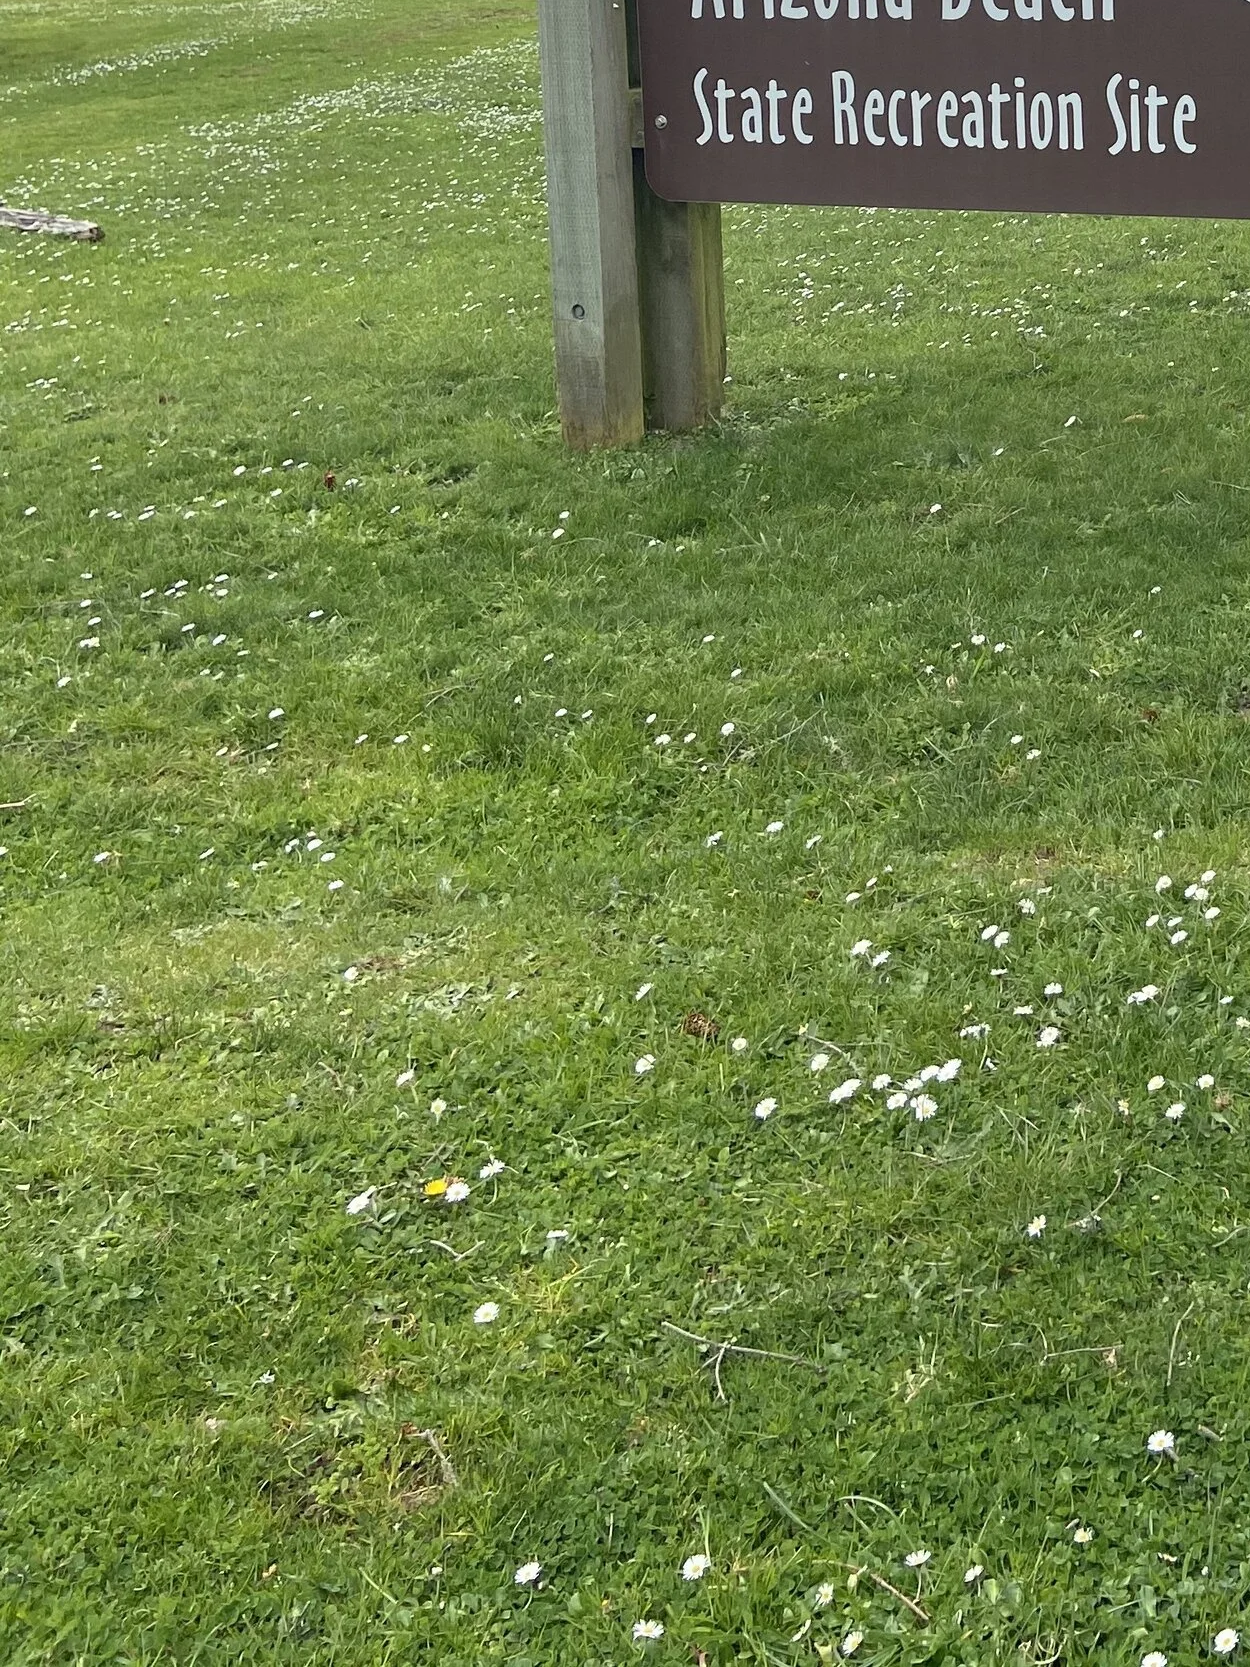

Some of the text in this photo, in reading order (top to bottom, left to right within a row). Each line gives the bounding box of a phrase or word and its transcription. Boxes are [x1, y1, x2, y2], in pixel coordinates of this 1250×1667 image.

[693, 67, 1198, 156] State Recreation Site
